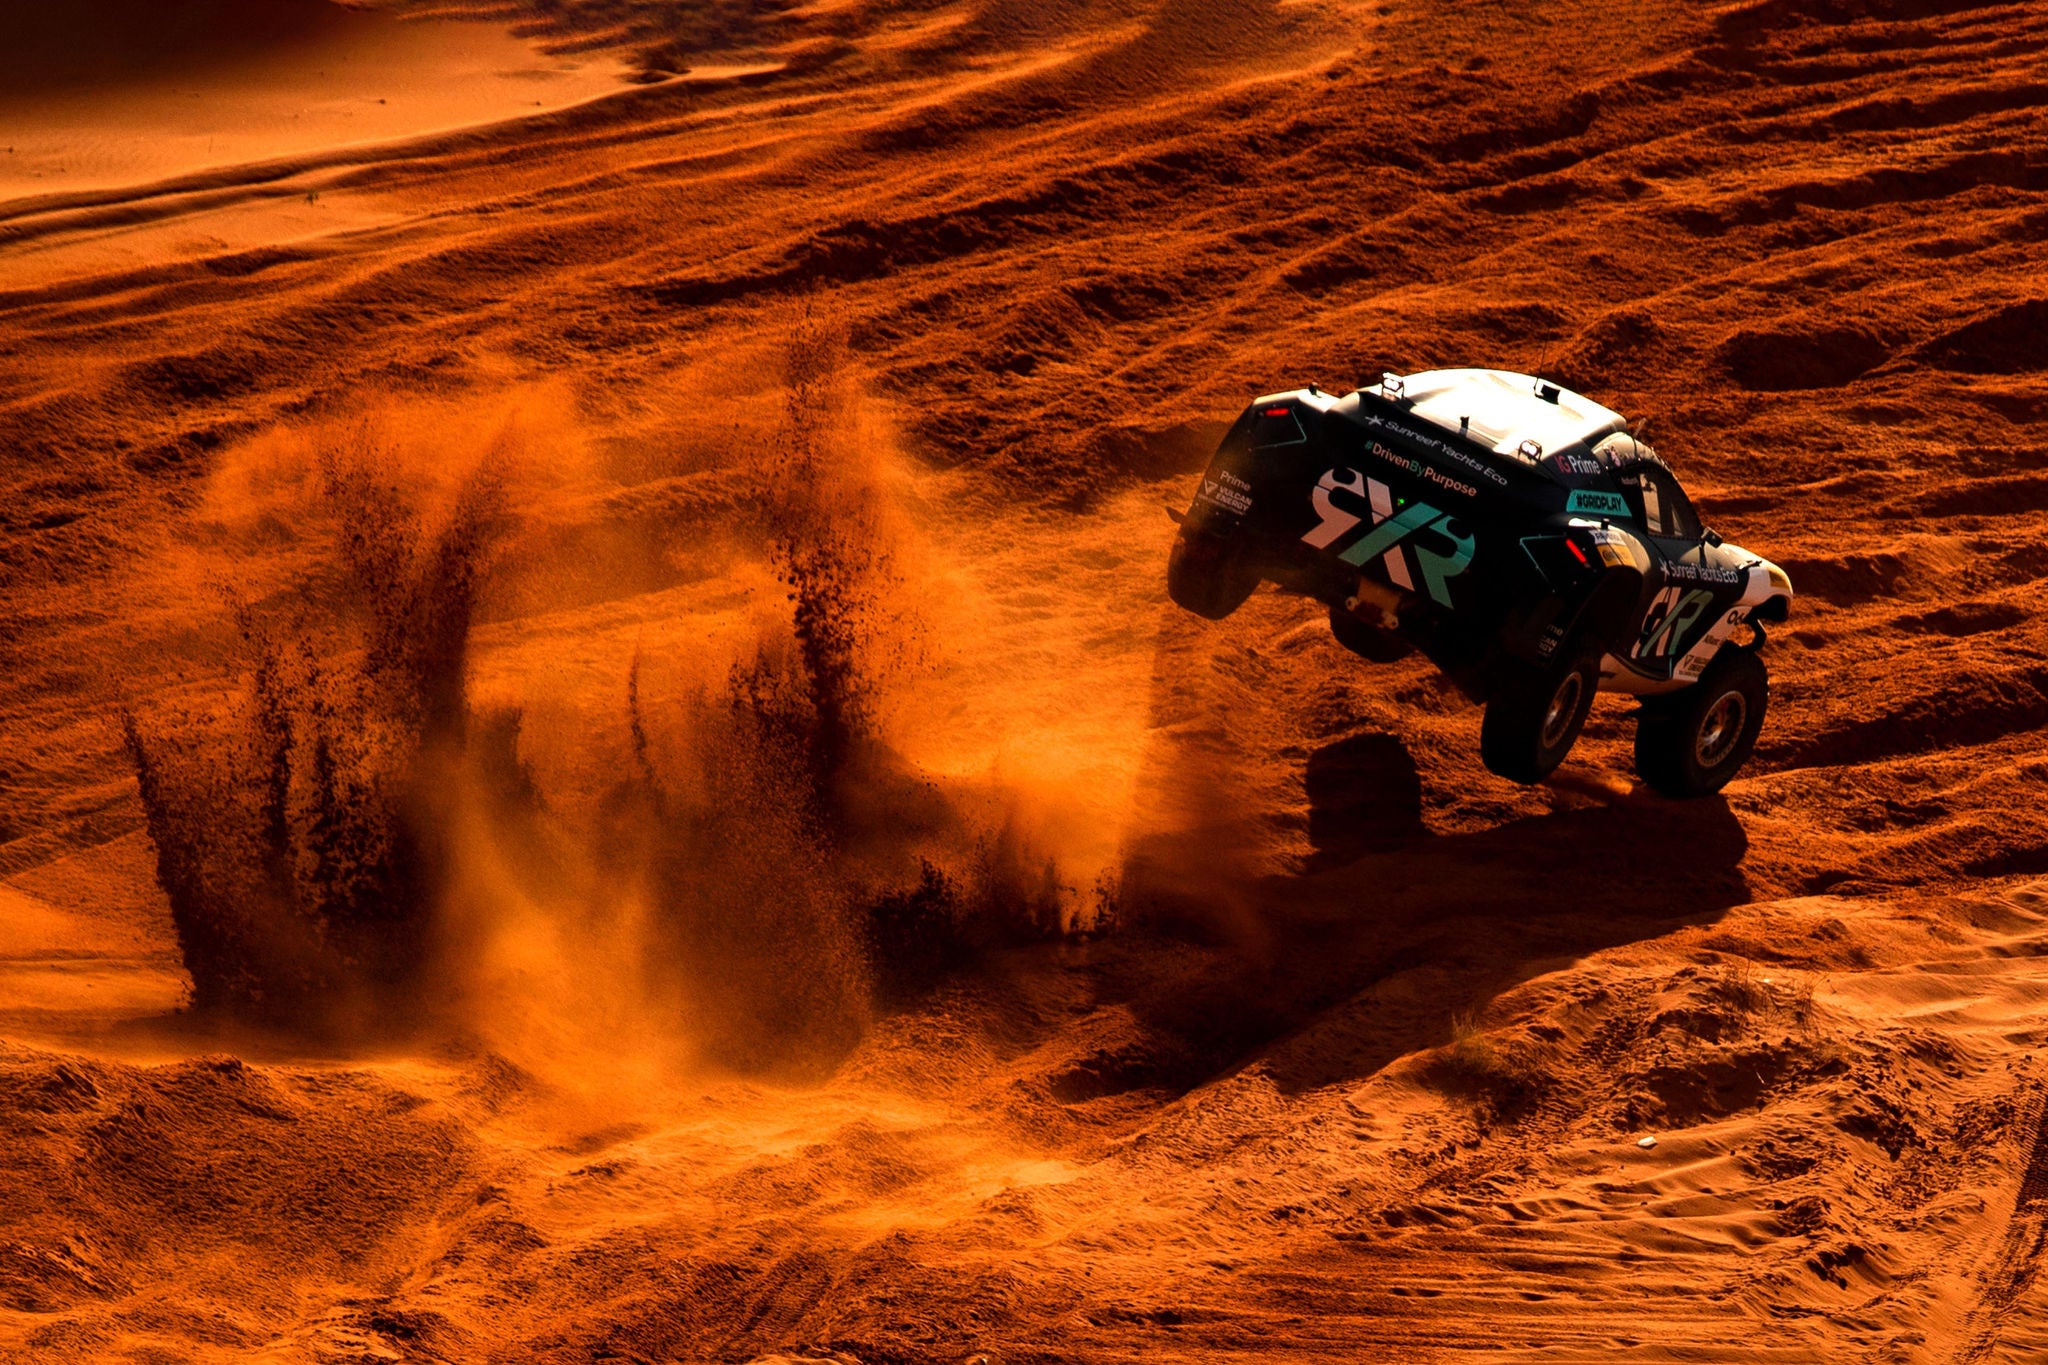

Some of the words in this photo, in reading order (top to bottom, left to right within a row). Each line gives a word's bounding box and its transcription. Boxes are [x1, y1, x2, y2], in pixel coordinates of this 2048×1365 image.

[1385, 421, 1441, 448] Sunreef
[1442, 443, 1484, 471] Yachts
[1483, 467, 1508, 486] Eco
[1364, 440, 1477, 497] #DrivenByPurpose
[1568, 454, 1600, 474] Prime
[1220, 470, 1251, 491] Prime
[1215, 493, 1249, 511] ENERGY
[1219, 485, 1252, 505] VULCAN
[1576, 493, 1622, 512] #GRIDPLAY
[1668, 559, 1697, 579] Sunreef
[1695, 563, 1723, 582] Yachts
[1720, 566, 1739, 584] Eco
